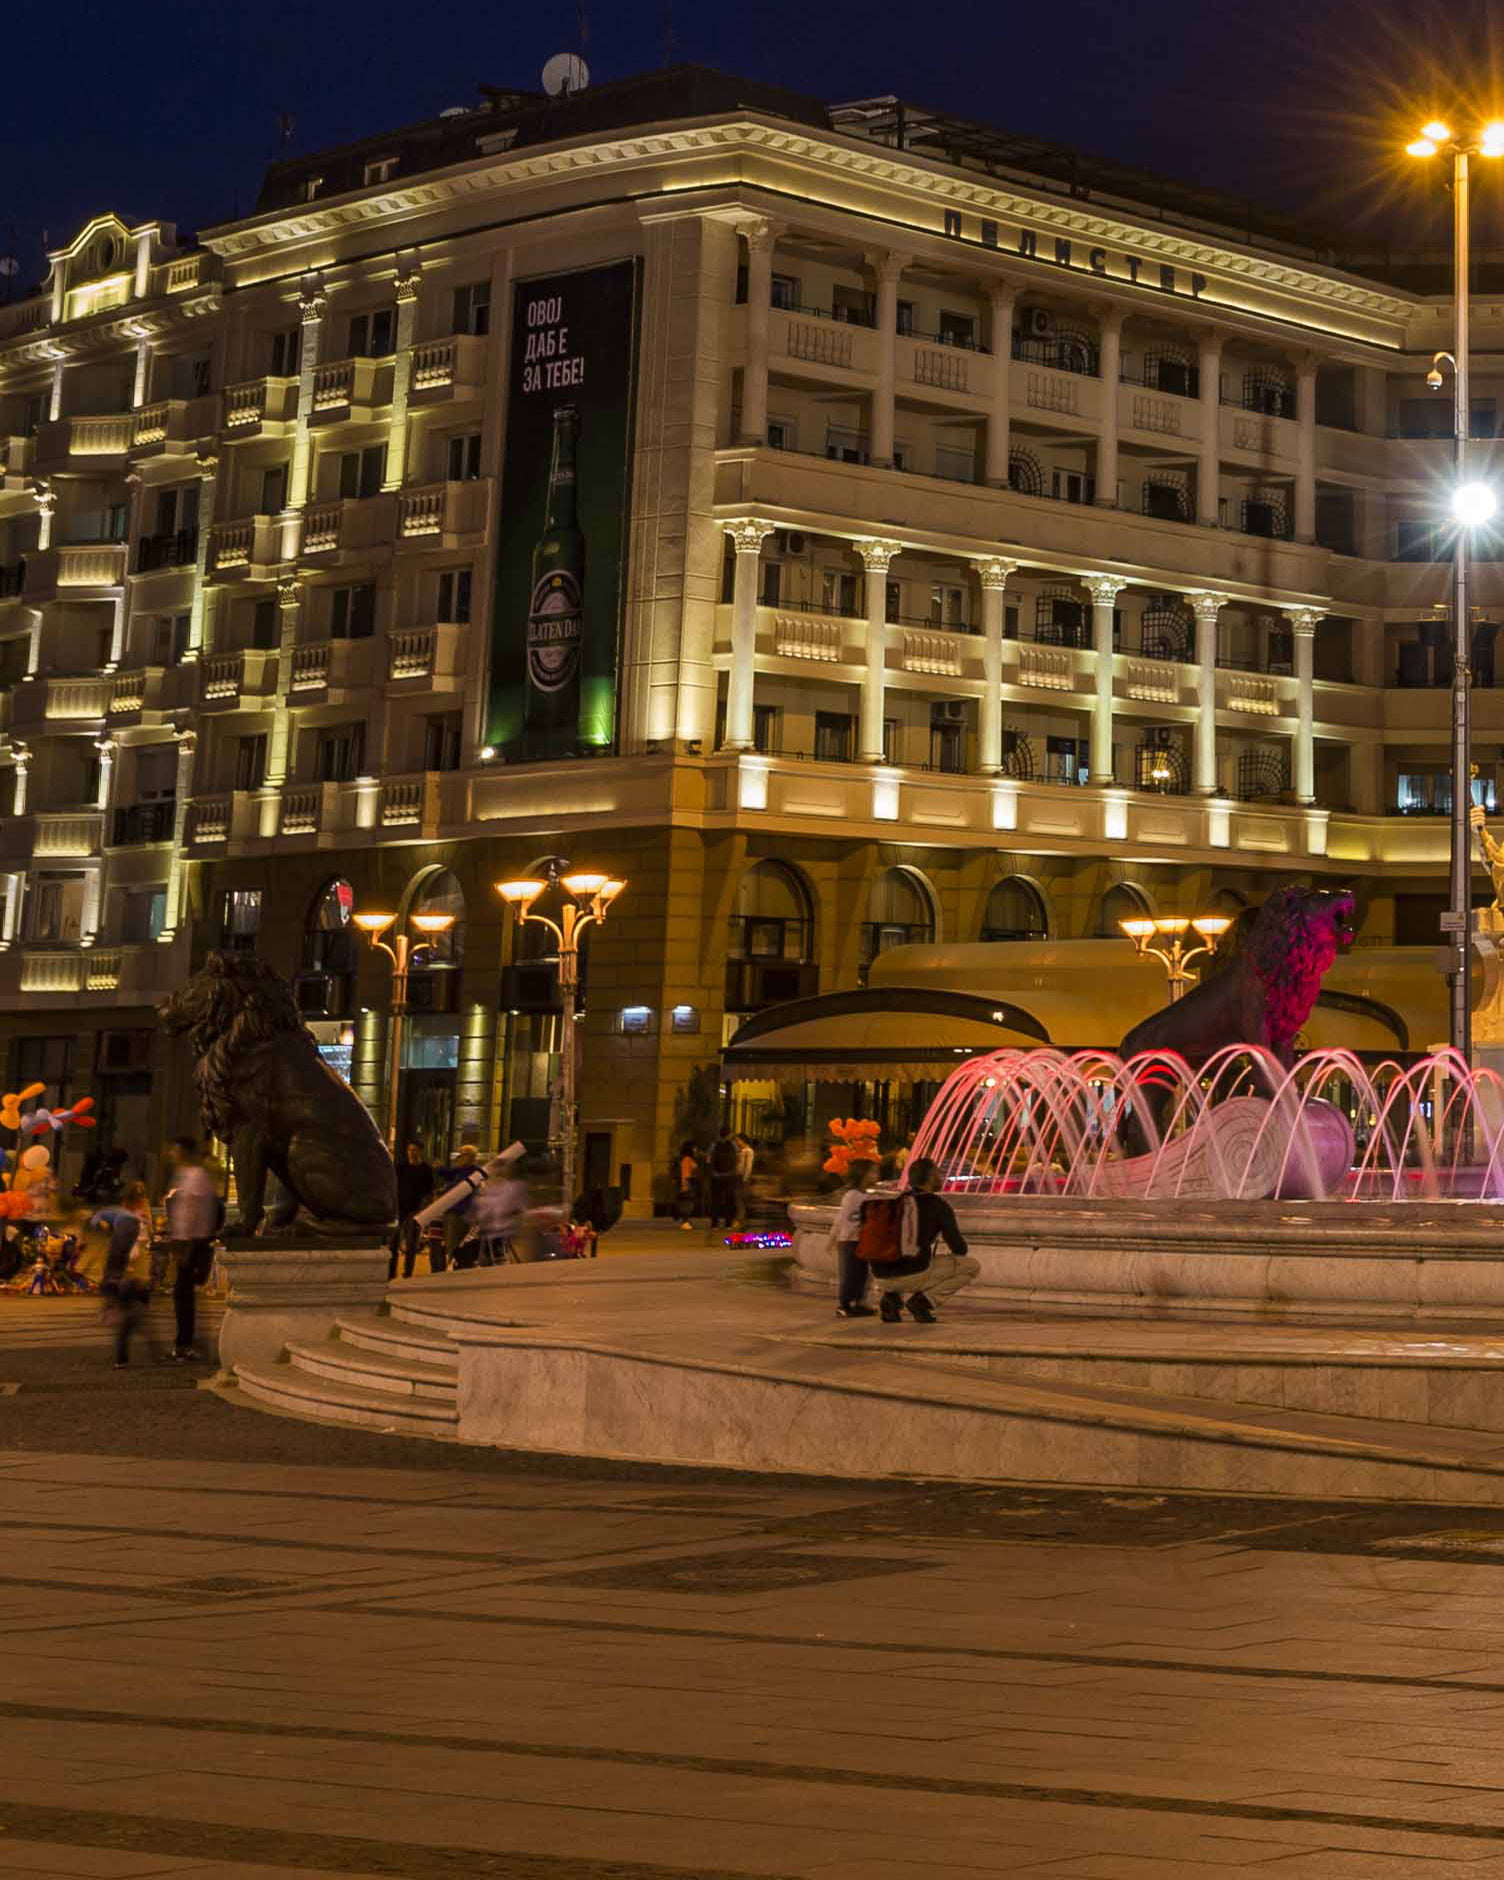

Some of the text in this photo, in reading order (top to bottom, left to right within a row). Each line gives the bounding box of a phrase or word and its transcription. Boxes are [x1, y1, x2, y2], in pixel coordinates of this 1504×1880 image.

[527, 296, 562, 328] ОВОЈ
[524, 330, 556, 364] ДАБ
[523, 356, 585, 392] ЗА ТЕБЕ!
